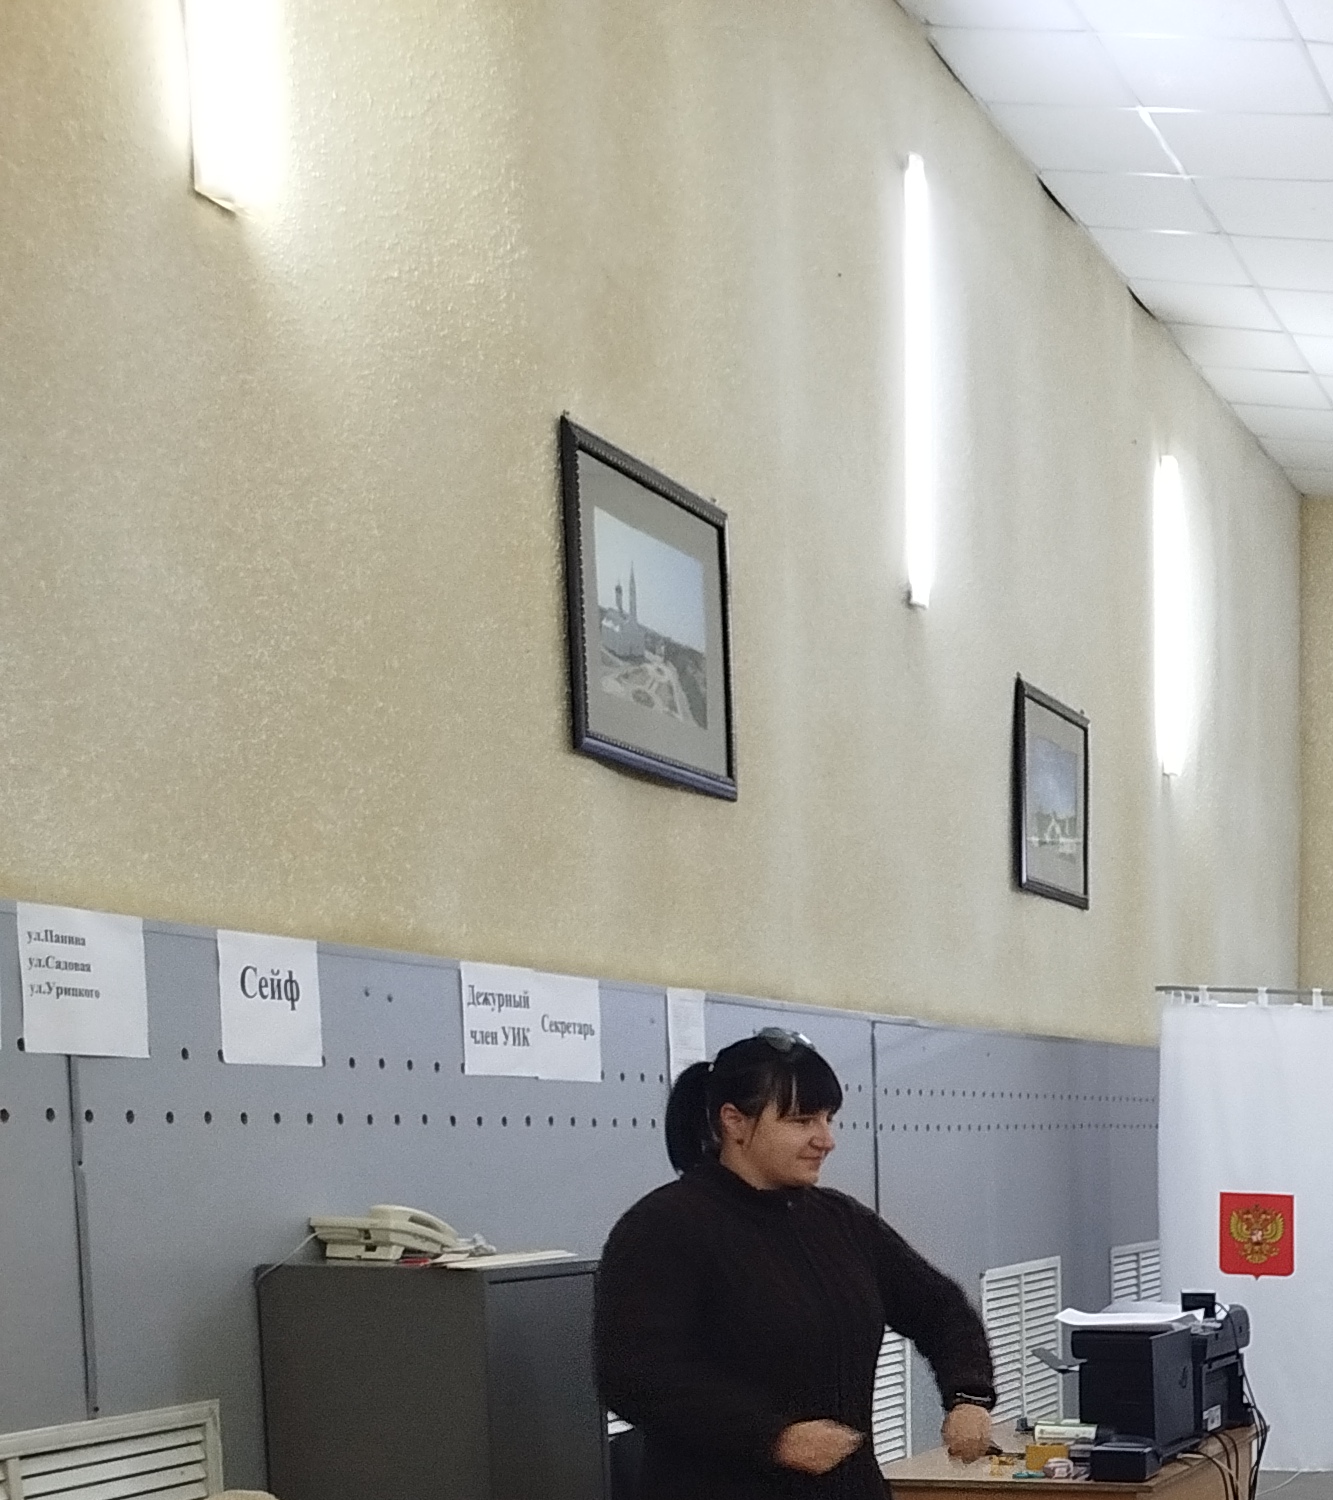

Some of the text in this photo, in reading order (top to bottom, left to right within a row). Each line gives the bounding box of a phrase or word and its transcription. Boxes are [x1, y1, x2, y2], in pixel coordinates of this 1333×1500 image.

[28, 955, 92, 973] ул.Садовая
[30, 981, 101, 1000] ул.Урицкого
[240, 965, 300, 1011] Сейф
[466, 984, 531, 1012] Дежурный
[470, 1026, 531, 1047] член УИК
[541, 1013, 596, 1040] Секретарь
